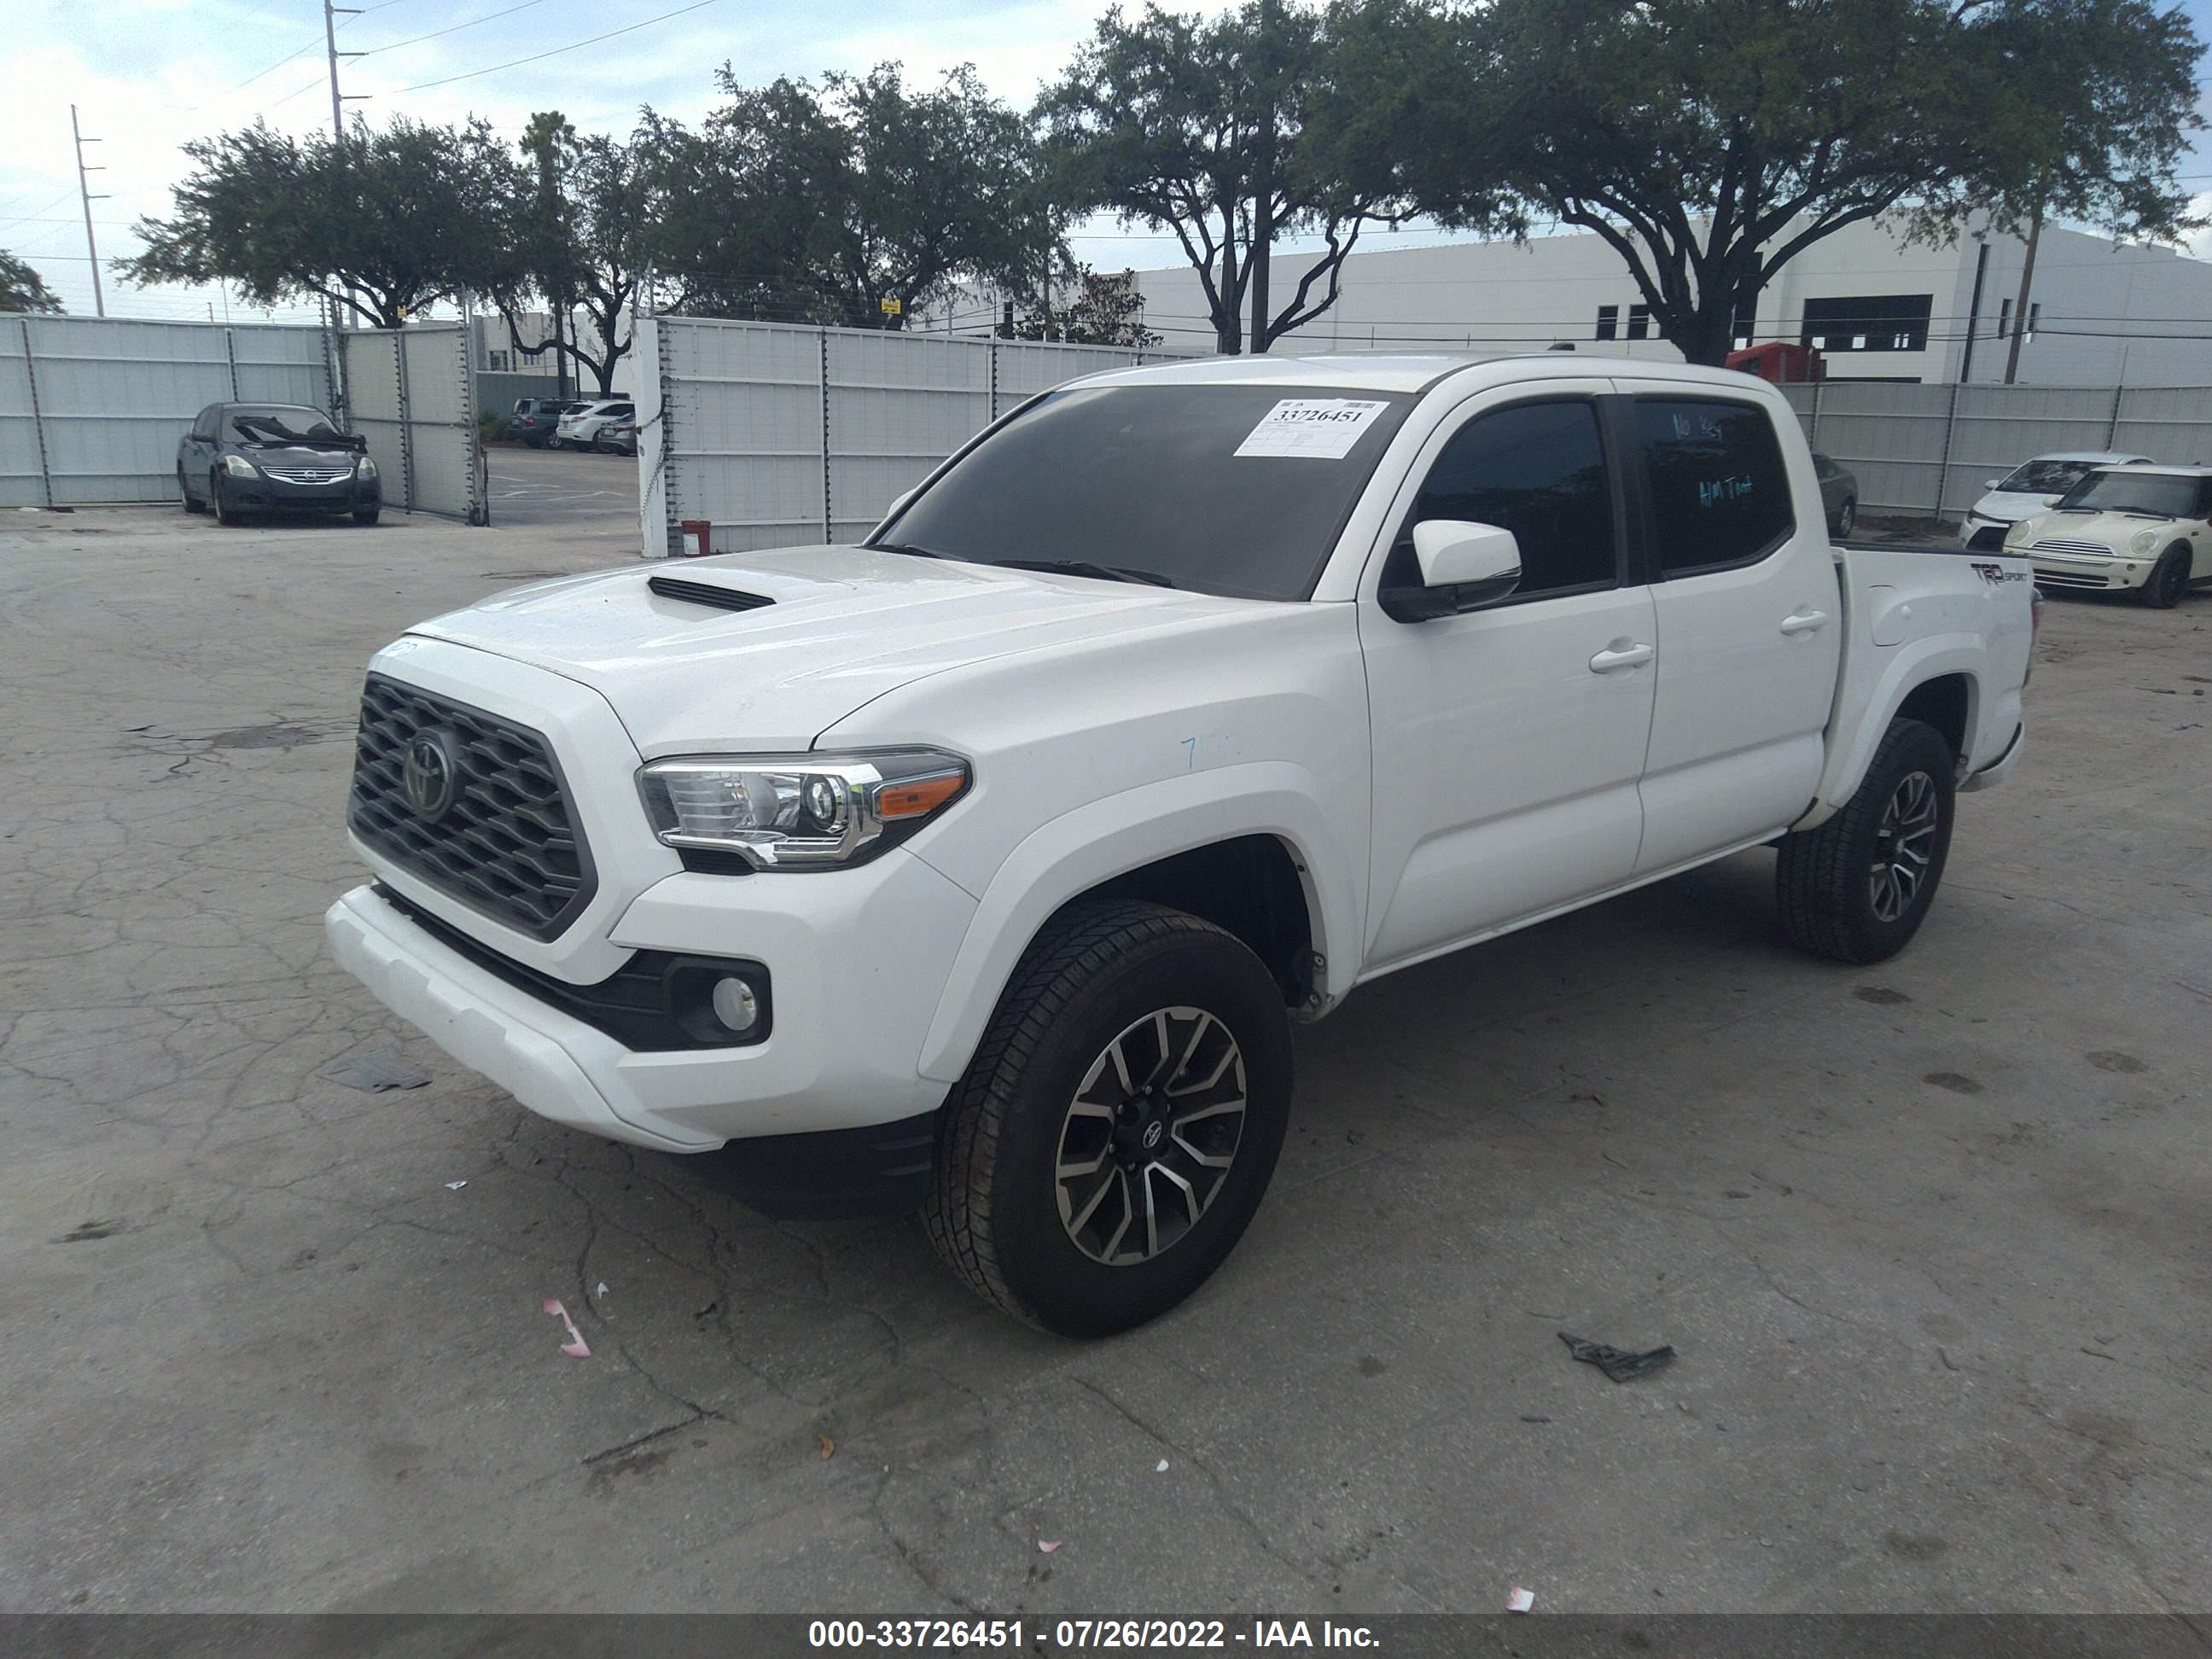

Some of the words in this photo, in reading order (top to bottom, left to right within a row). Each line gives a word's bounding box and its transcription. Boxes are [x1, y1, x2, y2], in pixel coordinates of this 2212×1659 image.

[1273, 410, 1364, 422] 33726451
[1970, 562, 2005, 587] TRD
[2004, 572, 2029, 582] SPORT
